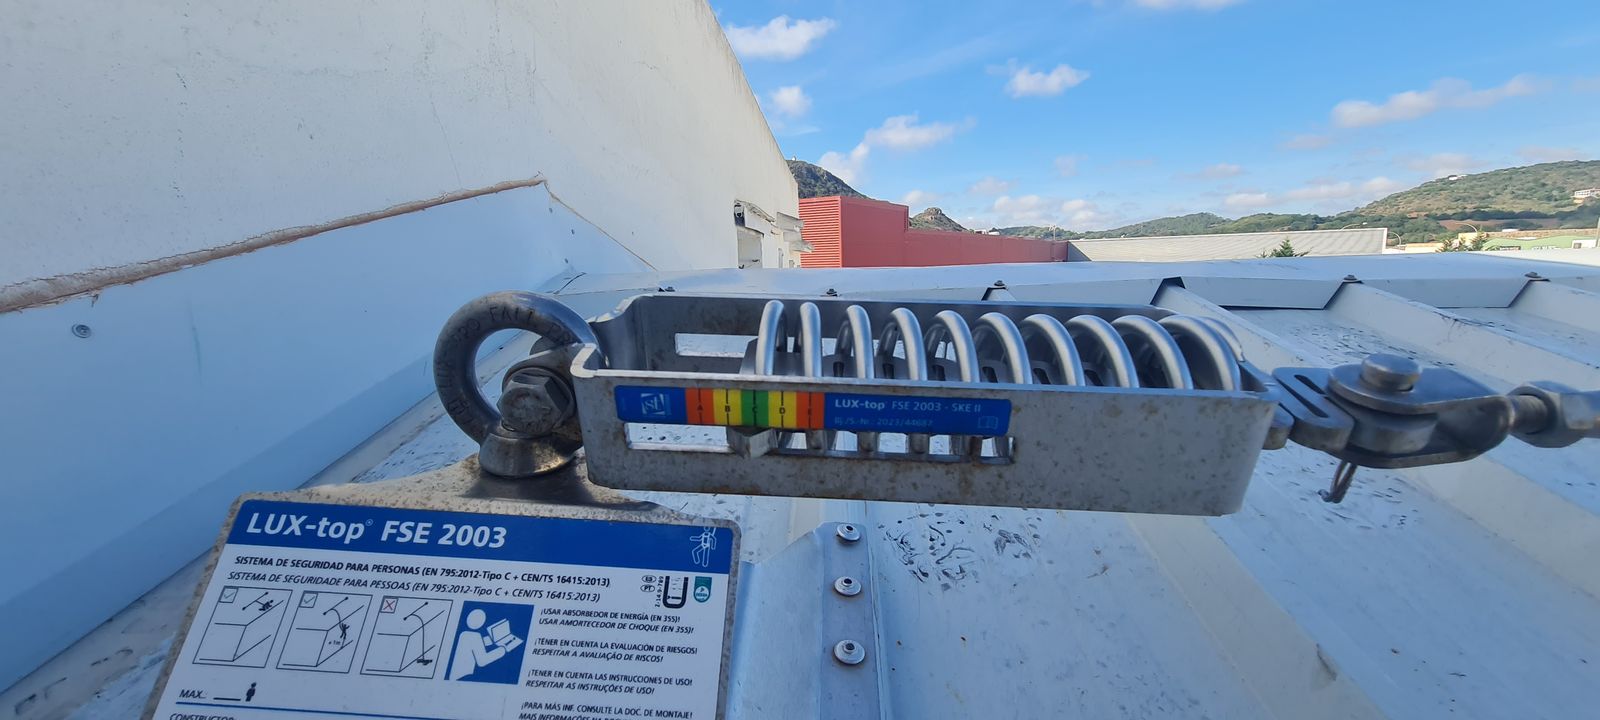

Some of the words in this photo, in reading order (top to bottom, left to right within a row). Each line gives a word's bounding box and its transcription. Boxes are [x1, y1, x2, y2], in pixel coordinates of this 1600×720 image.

[892, 401, 910, 410] FSE
[913, 401, 942, 412] 2003
[952, 403, 971, 412] SKE
[380, 520, 432, 544] FSE
[438, 524, 507, 548] 2003
[234, 556, 274, 567] SISTEMA
[276, 558, 289, 568] DE
[290, 559, 344, 571] SEGURIDAD
[346, 562, 369, 572] PARA
[371, 564, 420, 576] PERSONAS
[422, 566, 438, 578] (EN
[440, 568, 502, 582] 795:2012-Tipo
[504, 572, 512, 581] C
[521, 573, 554, 584] CEN/TS
[556, 574, 610, 588] 16415:2013)
[228, 571, 267, 582] SISTEMA
[268, 573, 281, 583] DE
[282, 574, 342, 587] SEGURIDADE
[344, 578, 369, 588] PARA
[370, 580, 411, 592] PESSOAS
[412, 582, 428, 593] (EN
[430, 583, 493, 597] 795:2012-Tipo
[495, 587, 503, 596] C
[512, 588, 544, 600] CEN/TS
[546, 590, 601, 603] 16415:2013)
[562, 609, 608, 618] ABSORBEDOR
[559, 619, 615, 629] AMORTECEDOR
[628, 622, 659, 633] CHOQUE
[661, 624, 673, 633] (EN
[571, 639, 598, 648] CUENTA
[656, 645, 665, 653] DE
[666, 646, 697, 655] RIESGOS!
[532, 648, 570, 657] RESPEITAR
[635, 654, 664, 663] RISCOS!
[565, 671, 593, 680] CUENTA
[595, 673, 607, 681] LAS
[609, 674, 662, 684] INSTRUCCIONES
[675, 678, 693, 686] USO!
[526, 680, 564, 689] RESPEITAR
[636, 686, 655, 695] USO!
[577, 705, 613, 714] CONSULTE
[654, 710, 693, 719] MONTAJE!
